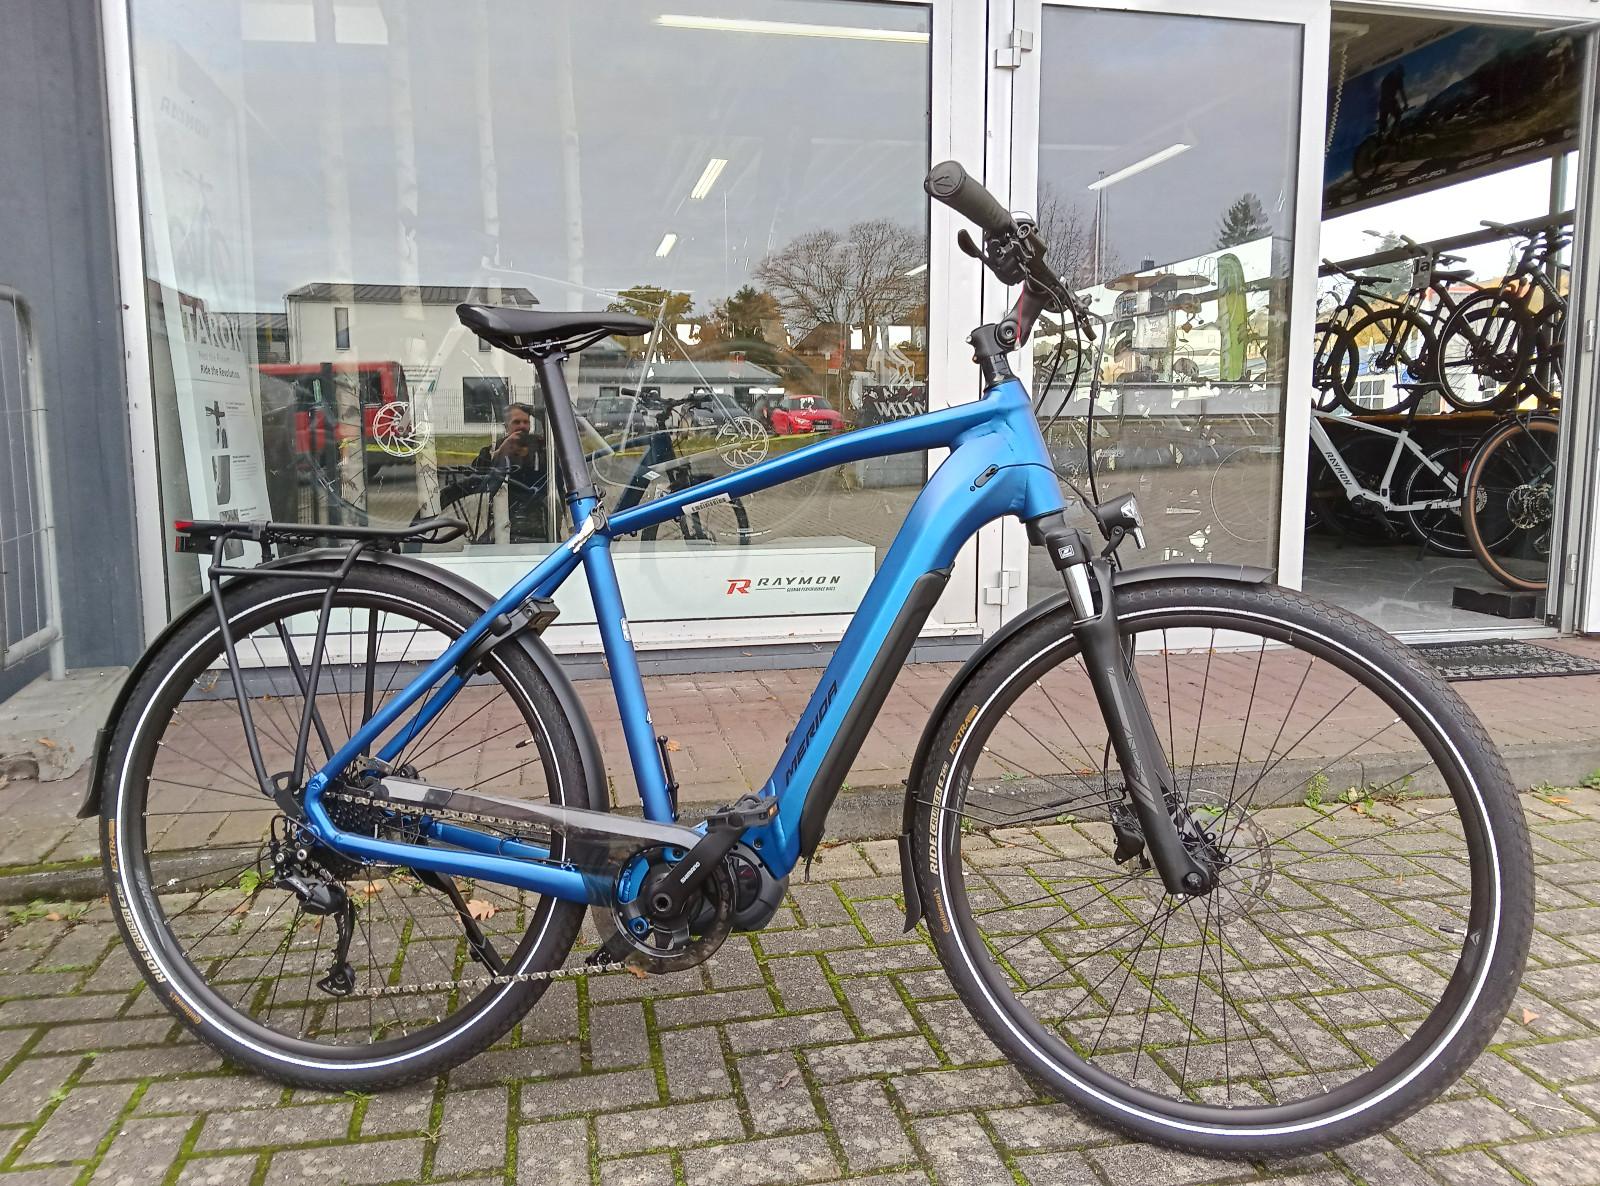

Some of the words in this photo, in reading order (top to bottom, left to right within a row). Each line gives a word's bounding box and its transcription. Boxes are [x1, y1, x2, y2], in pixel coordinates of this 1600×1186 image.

[1325, 451, 1353, 485] RAYMON
[757, 576, 840, 587] RAYMON
[786, 680, 838, 787] MERIDA
[951, 717, 972, 753] EXTRA
[930, 787, 942, 835] CRUISER
[929, 835, 939, 876] RIDE
[123, 911, 145, 950] CRUISER
[140, 952, 167, 983] RIDE
